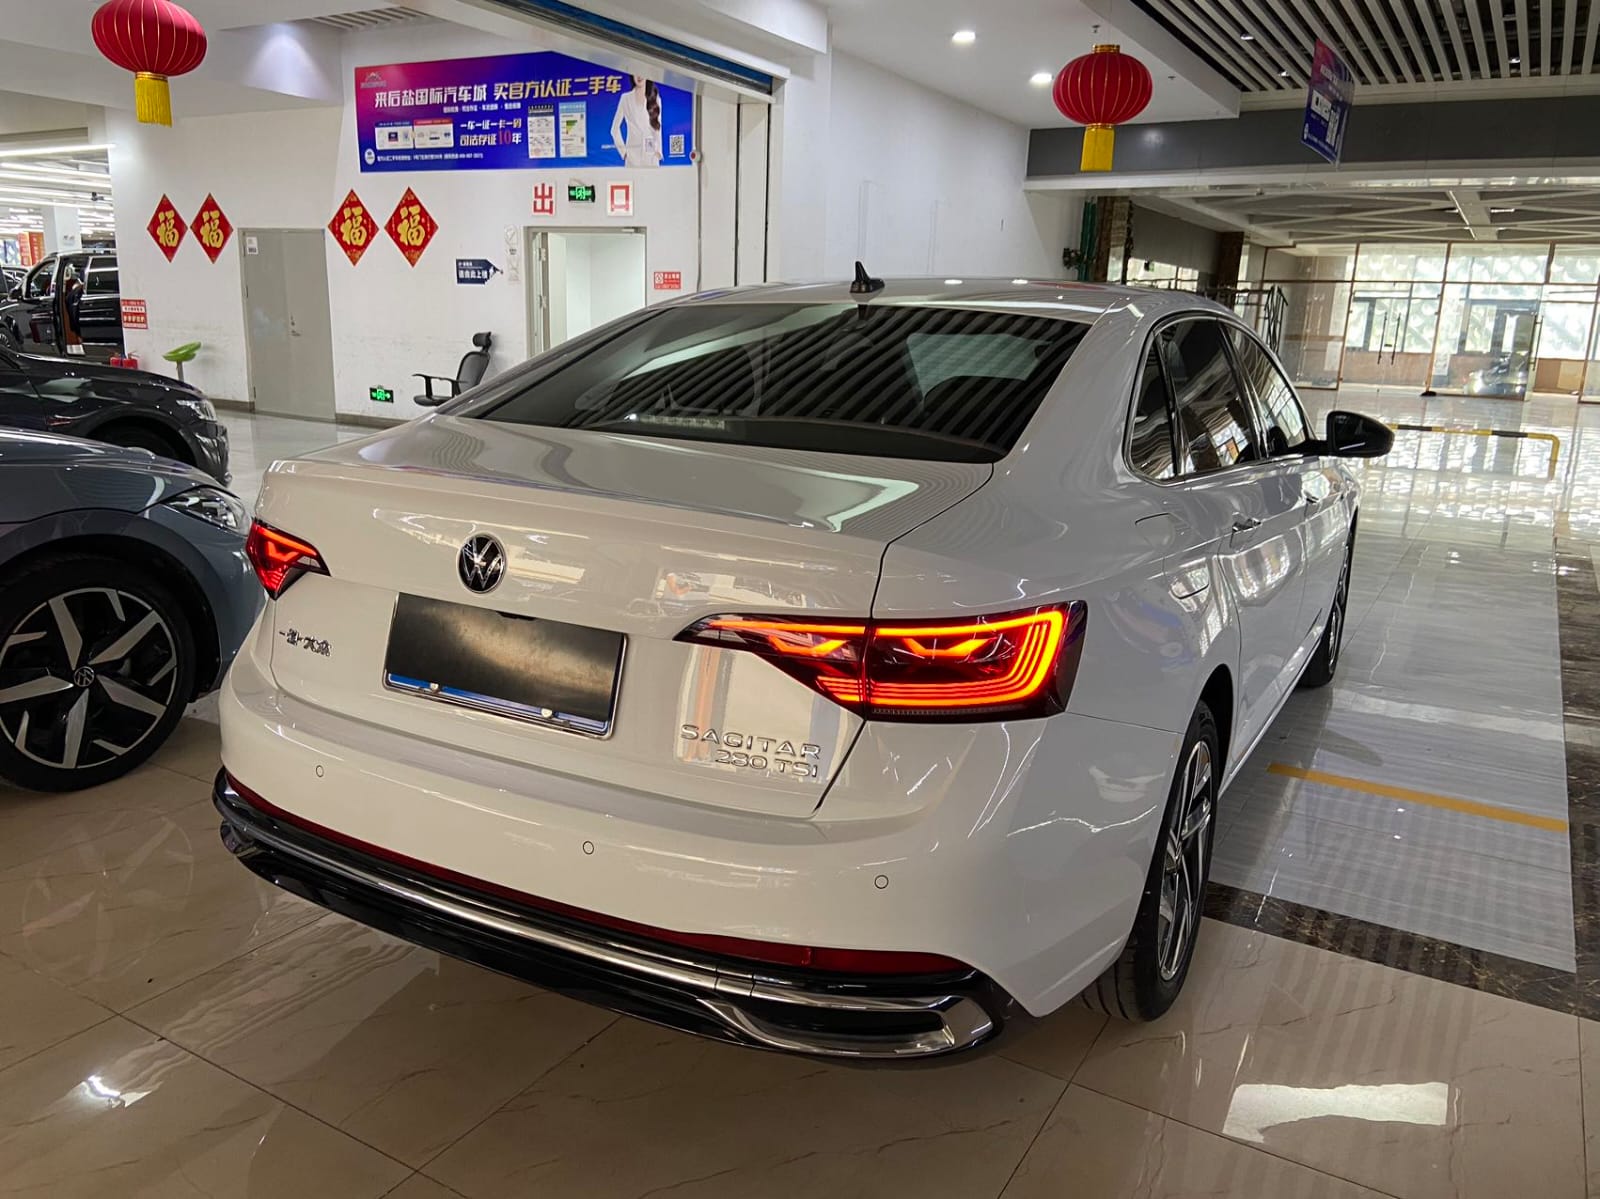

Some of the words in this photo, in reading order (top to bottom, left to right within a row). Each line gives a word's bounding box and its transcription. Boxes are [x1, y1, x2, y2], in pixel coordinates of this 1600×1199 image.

[493, 75, 622, 100] 买官方认证二手车
[533, 183, 554, 215] 出
[157, 209, 180, 247] 福
[200, 209, 224, 248] 福
[340, 206, 367, 247] 福
[397, 204, 425, 246] 福
[681, 724, 821, 760] SAGITAR
[775, 757, 819, 778] TSI
